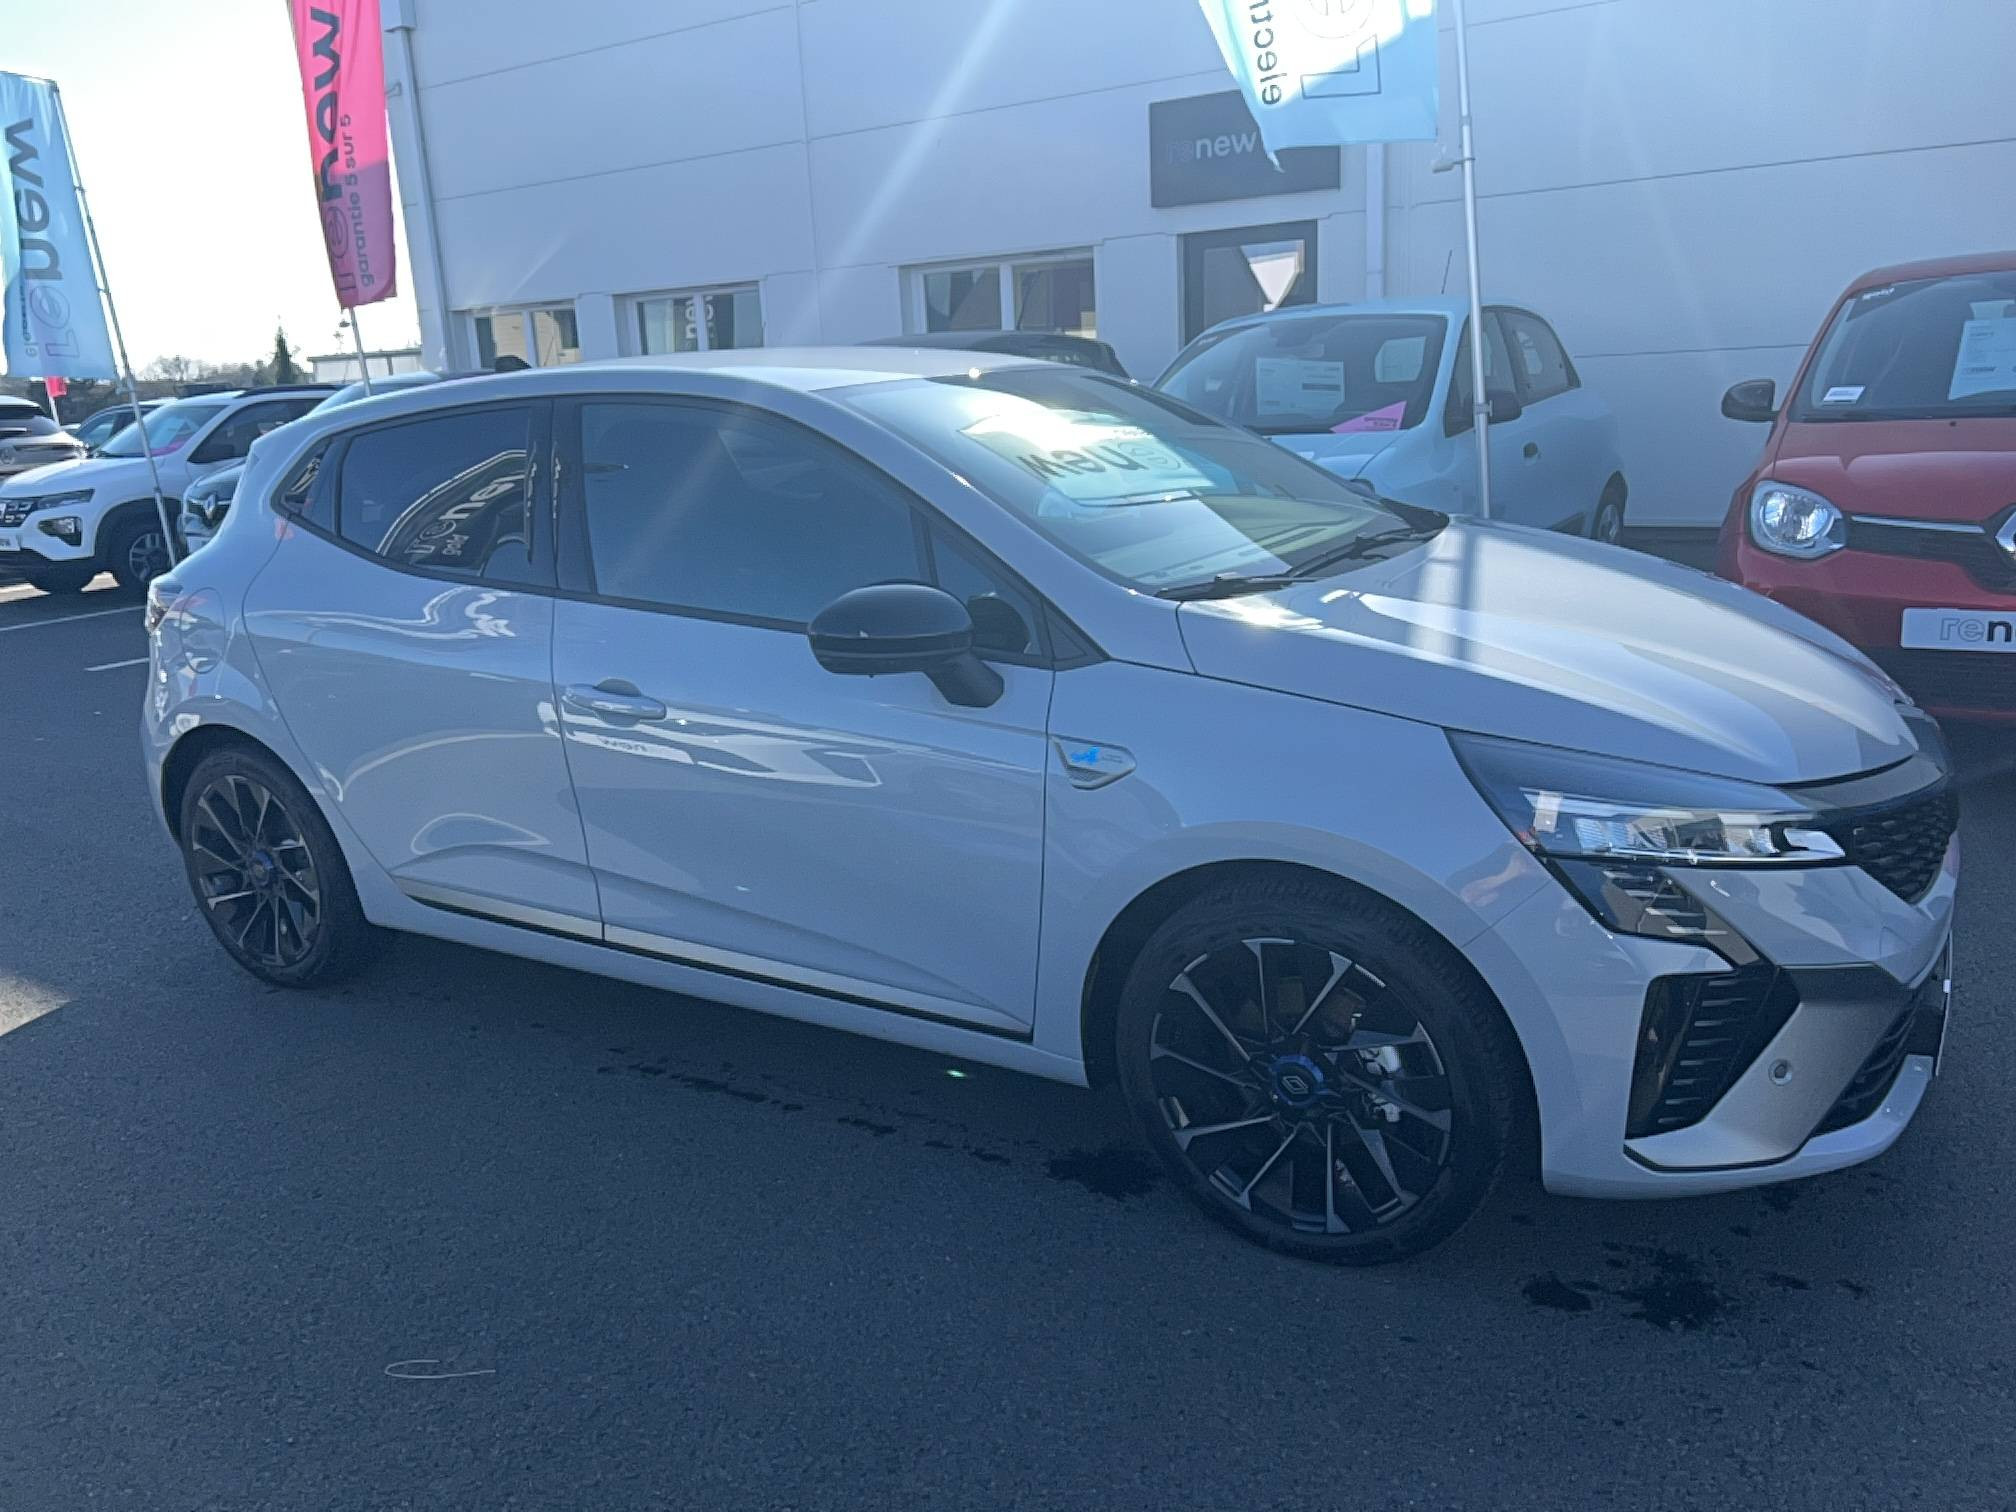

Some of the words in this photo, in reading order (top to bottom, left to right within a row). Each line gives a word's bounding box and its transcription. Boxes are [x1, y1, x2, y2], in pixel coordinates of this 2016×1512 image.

[340, 113, 353, 127] 5
[311, 6, 356, 293] renew
[344, 131, 357, 170] sur
[344, 172, 359, 187] 5
[350, 191, 375, 288] garantie
[1940, 616, 2016, 643] ren
